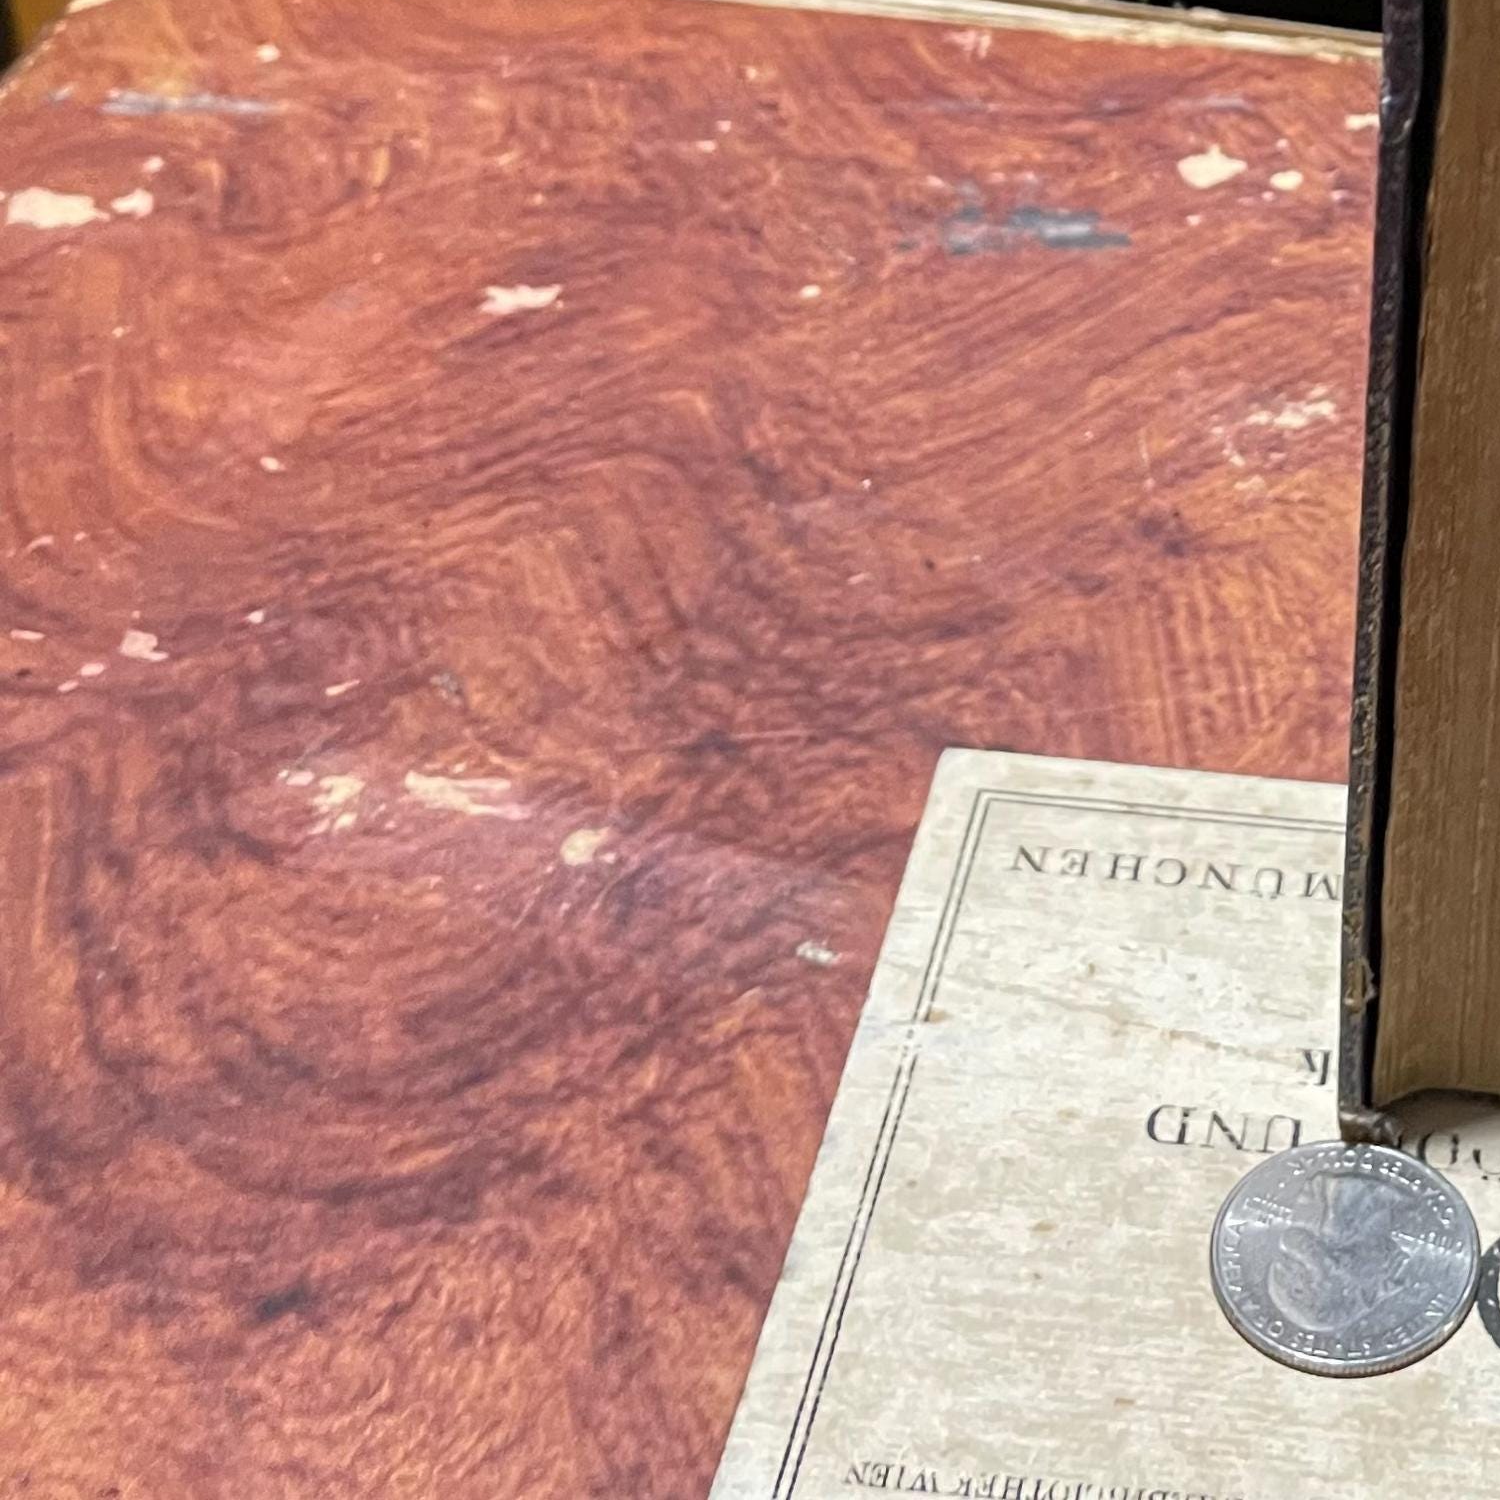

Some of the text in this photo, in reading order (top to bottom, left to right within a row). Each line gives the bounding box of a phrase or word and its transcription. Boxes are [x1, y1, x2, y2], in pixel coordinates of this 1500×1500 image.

[1006, 844, 1342, 903] MÜNCHEN
[1148, 1102, 1303, 1153] UND
[842, 1461, 939, 1494] WIEN
